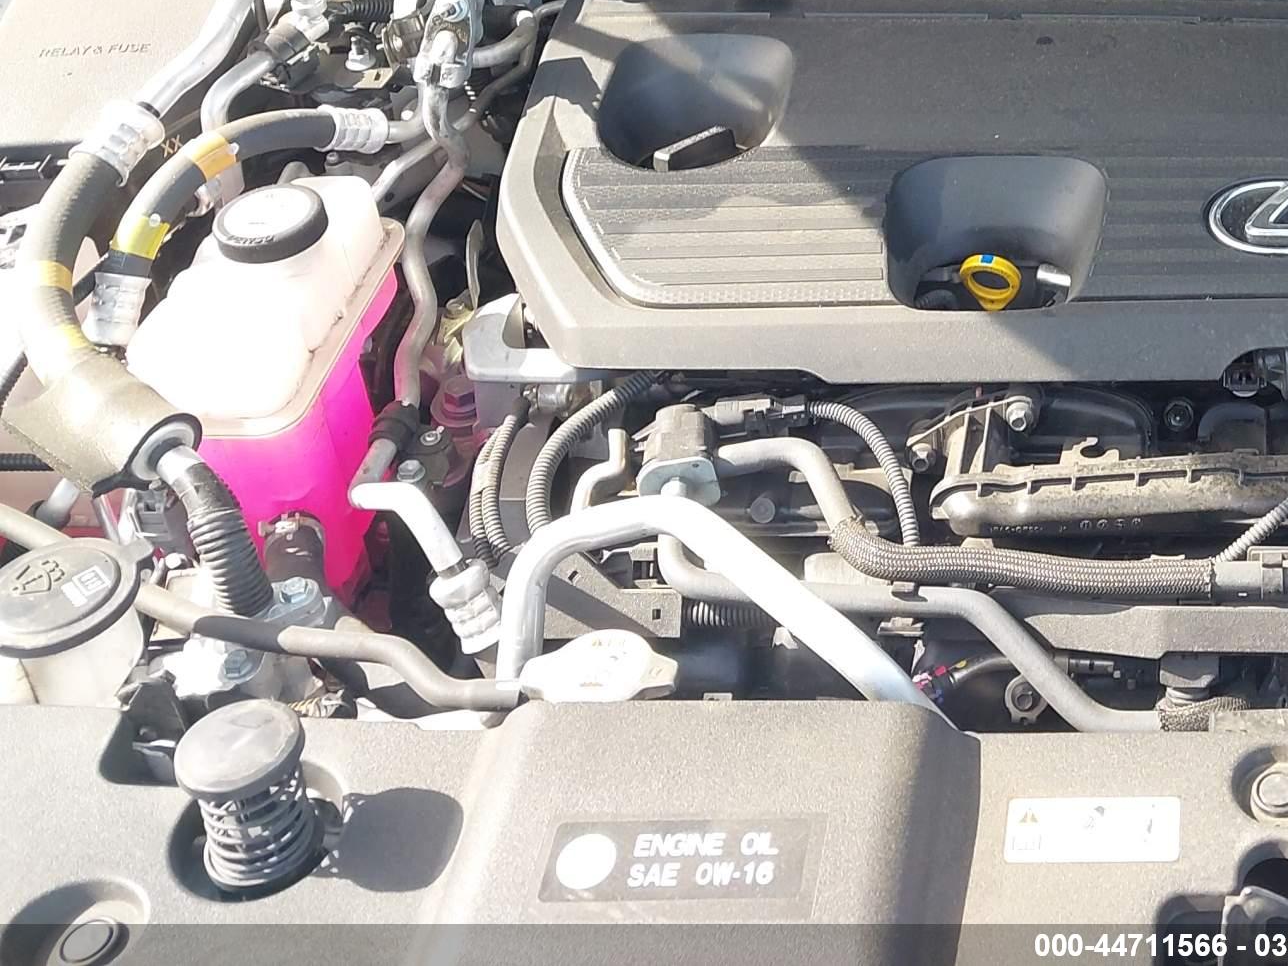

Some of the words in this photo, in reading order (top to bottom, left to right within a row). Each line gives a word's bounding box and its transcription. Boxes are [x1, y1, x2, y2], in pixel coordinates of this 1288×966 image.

[633, 832, 726, 857] ENGINE
[740, 832, 779, 856] OIL
[627, 862, 681, 887] SAE
